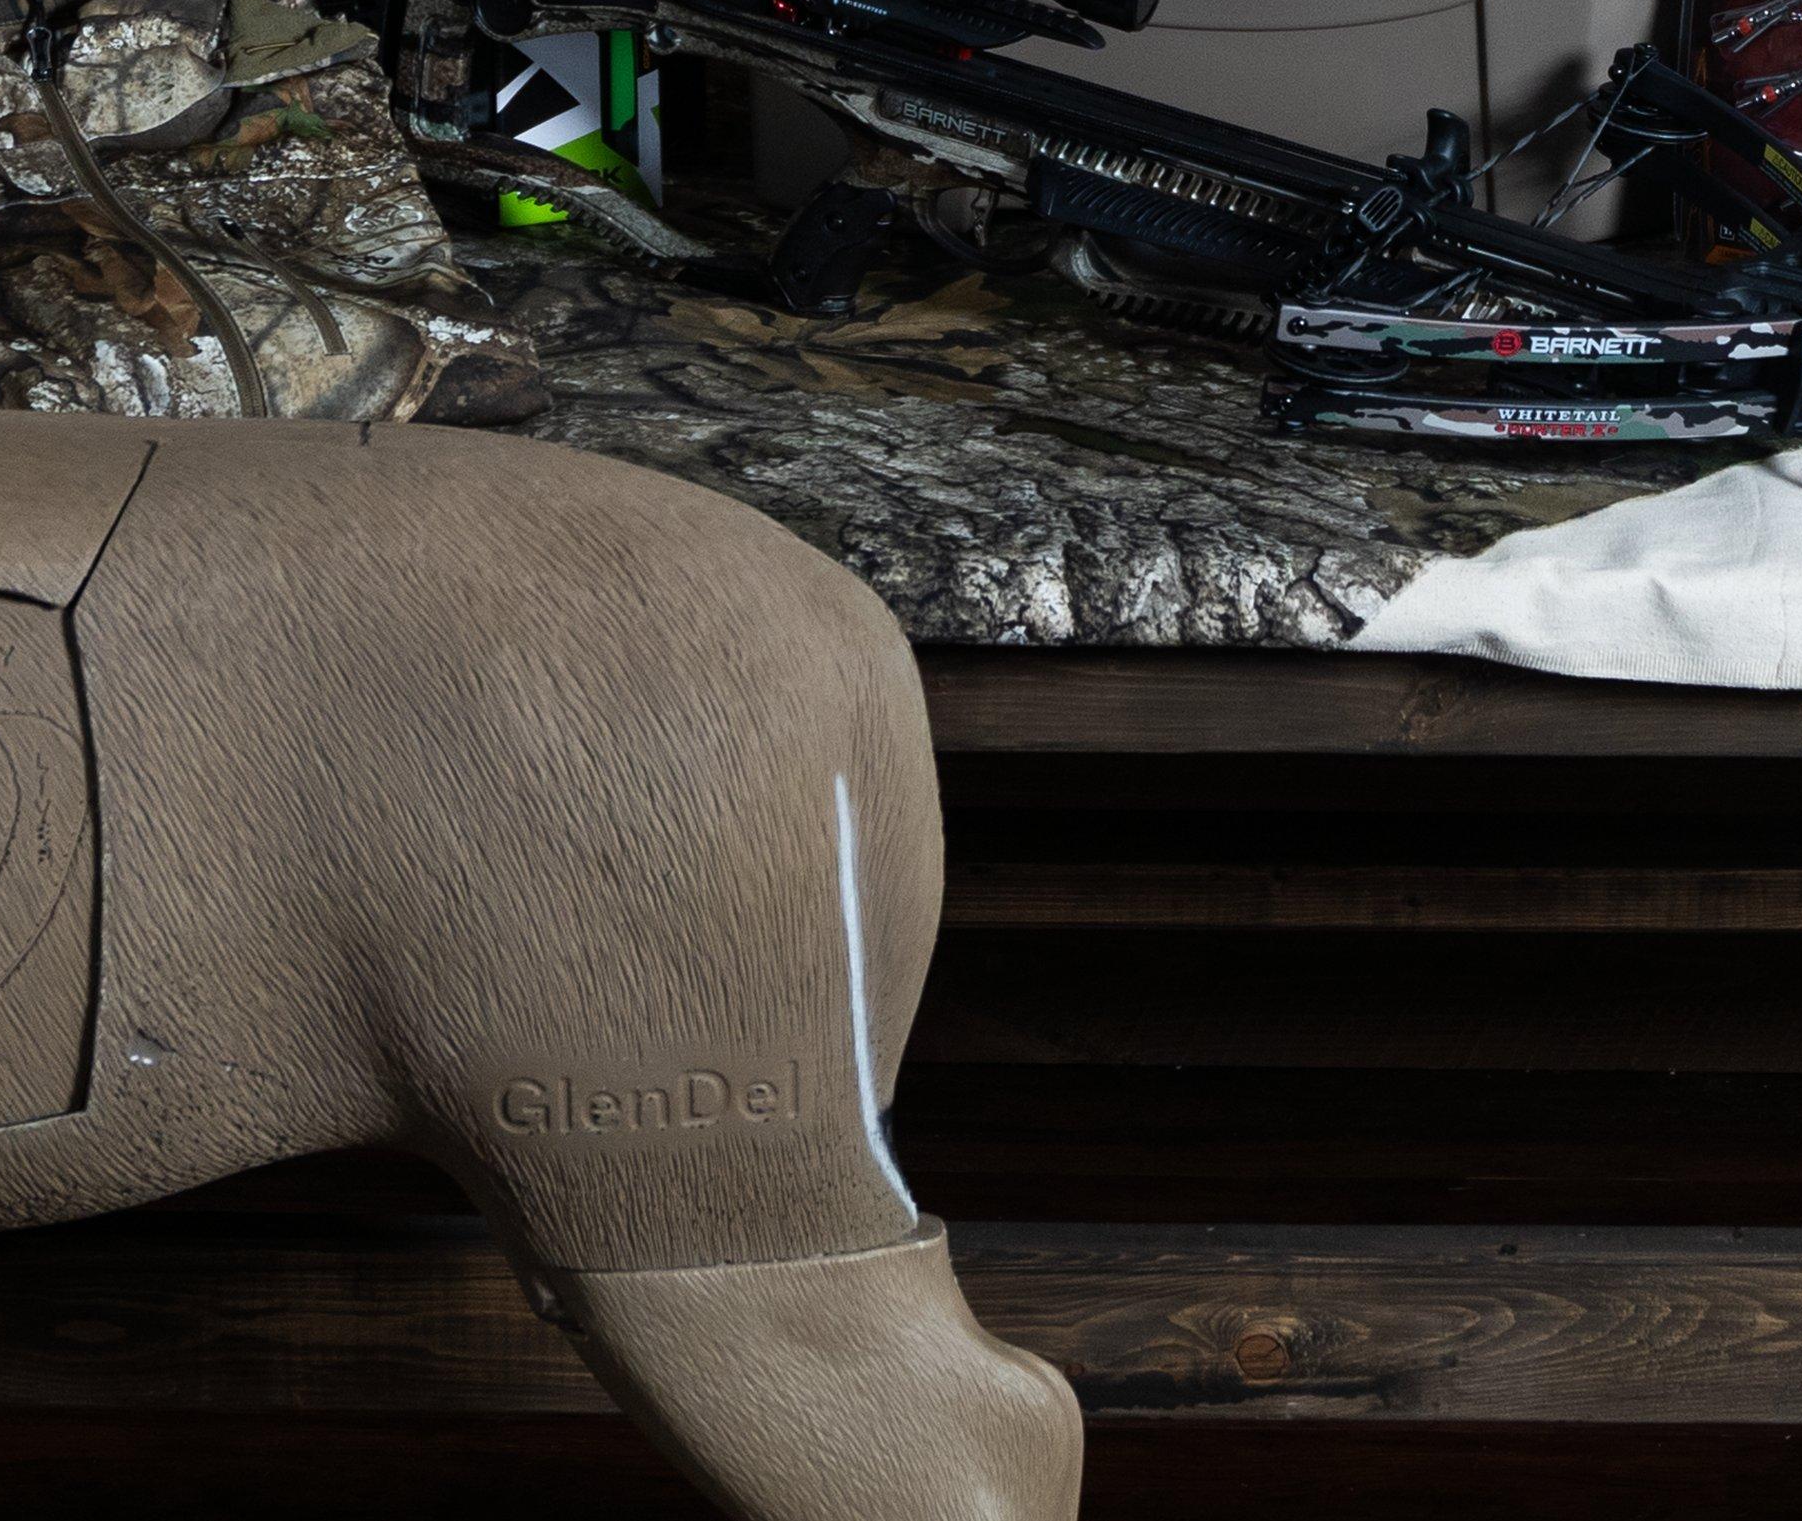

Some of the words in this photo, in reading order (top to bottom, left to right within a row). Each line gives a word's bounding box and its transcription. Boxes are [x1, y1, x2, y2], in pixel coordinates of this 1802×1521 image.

[903, 101, 1007, 145] BARNETT
[1529, 336, 1654, 355] BARNETT
[1497, 407, 1622, 422] WHITETAIL
[1507, 423, 1587, 438] HUNTER
[495, 1060, 799, 1135] GlenDel
